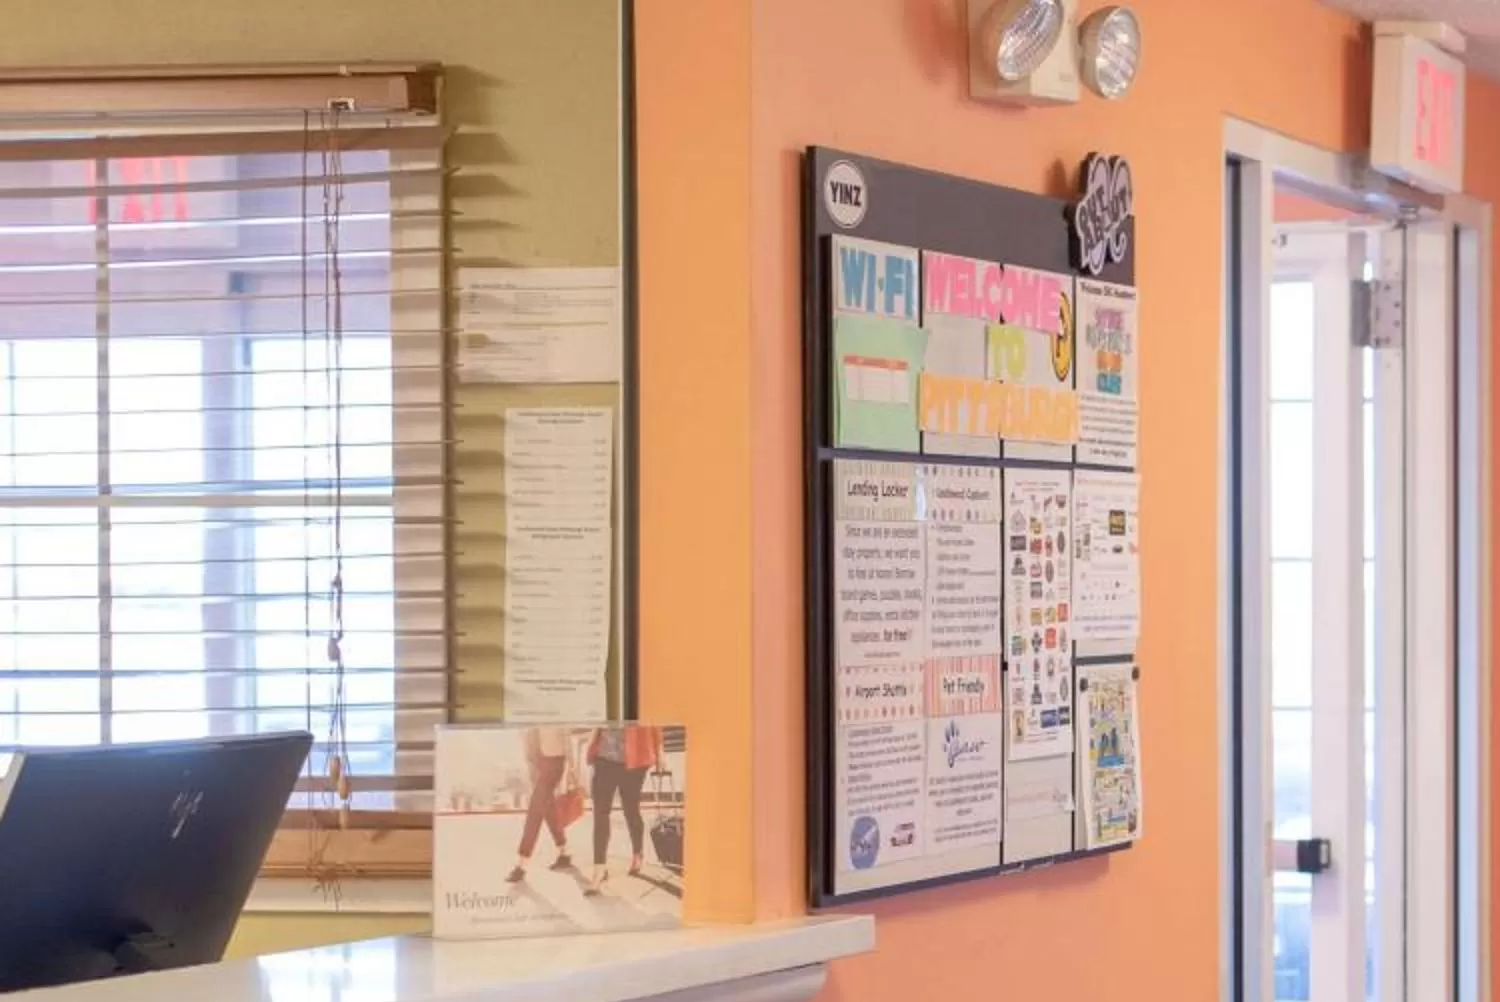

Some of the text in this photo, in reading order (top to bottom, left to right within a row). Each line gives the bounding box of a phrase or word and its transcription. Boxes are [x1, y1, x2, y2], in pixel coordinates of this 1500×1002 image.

[830, 180, 862, 207] YINZ
[928, 255, 1061, 334] WELCOME
[990, 324, 1025, 379] TO
[847, 480, 909, 502] Lending Locker
[855, 683, 907, 698] Airport Shuttle
[943, 677, 985, 695] Pet Friendly
